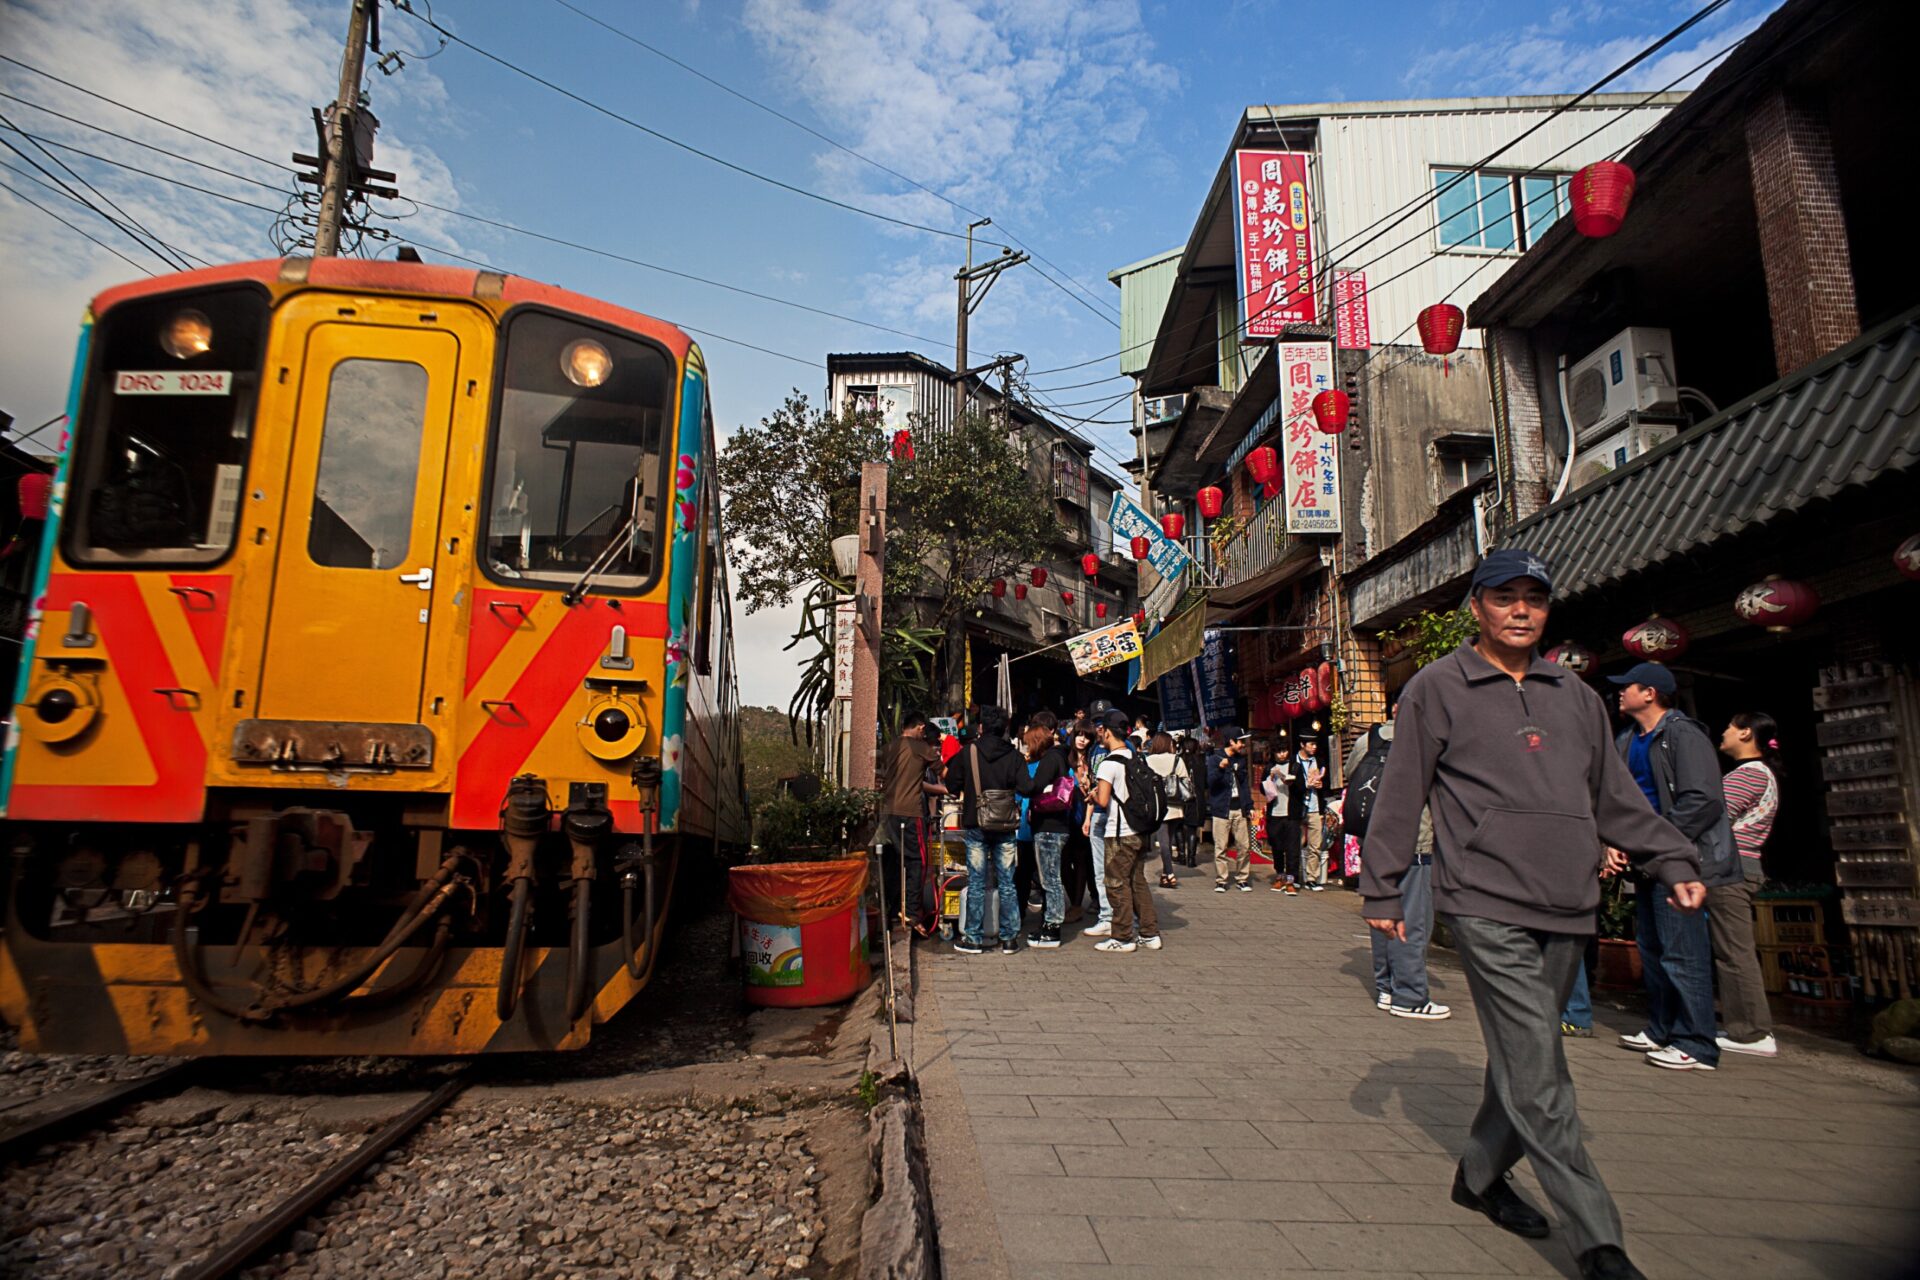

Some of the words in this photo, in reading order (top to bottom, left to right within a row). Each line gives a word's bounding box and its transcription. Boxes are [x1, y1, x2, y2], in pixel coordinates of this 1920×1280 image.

[1260, 160, 1290, 305] 周萬珍餅店
[1284, 347, 1328, 361] 百年老店
[119, 374, 166, 391] DRC
[178, 374, 223, 391] 1024
[1289, 362, 1318, 508] 周萬珍餅店
[1320, 442, 1335, 495] 十分名產
[1292, 520, 1338, 529] 02-24958225
